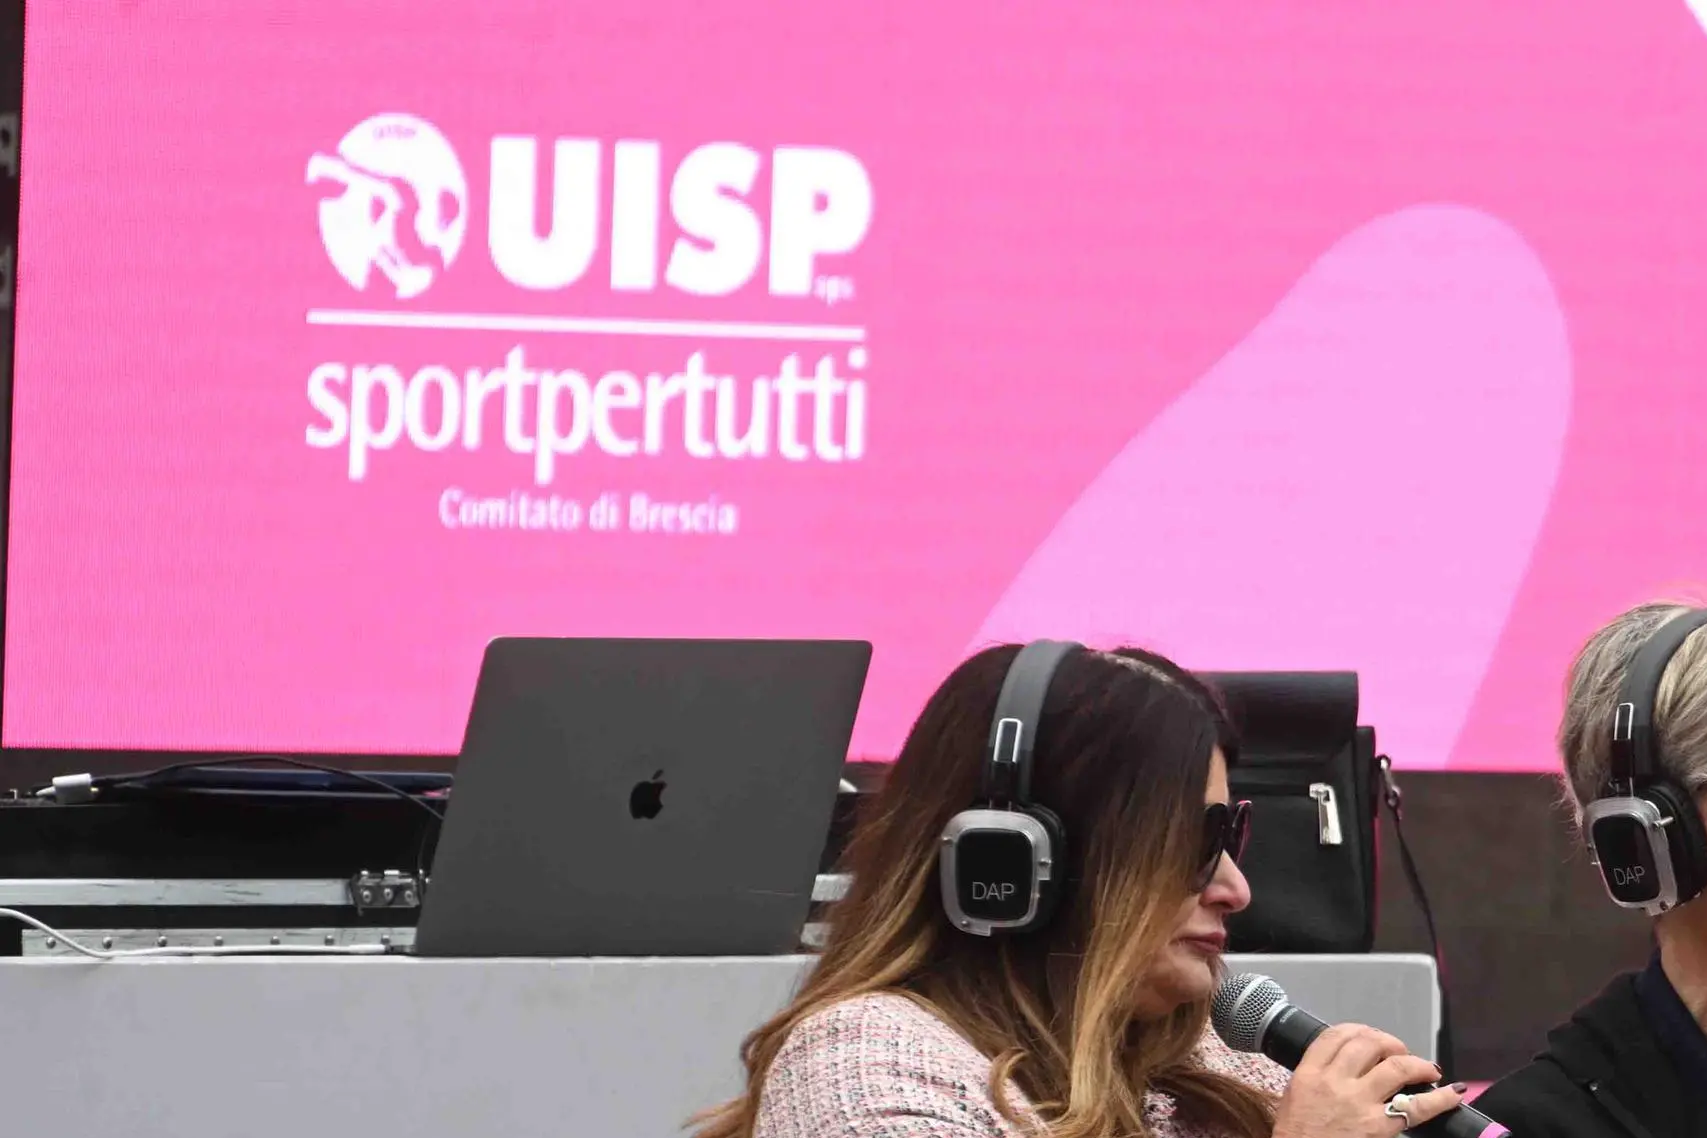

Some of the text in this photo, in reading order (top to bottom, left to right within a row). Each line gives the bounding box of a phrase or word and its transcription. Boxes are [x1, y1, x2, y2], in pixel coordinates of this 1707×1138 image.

[487, 135, 873, 297] UISP
[306, 344, 867, 485] sportpertutti
[438, 487, 738, 535] Comitato di Brescia
[971, 881, 1016, 901] DAP
[1613, 865, 1646, 886] DAP
